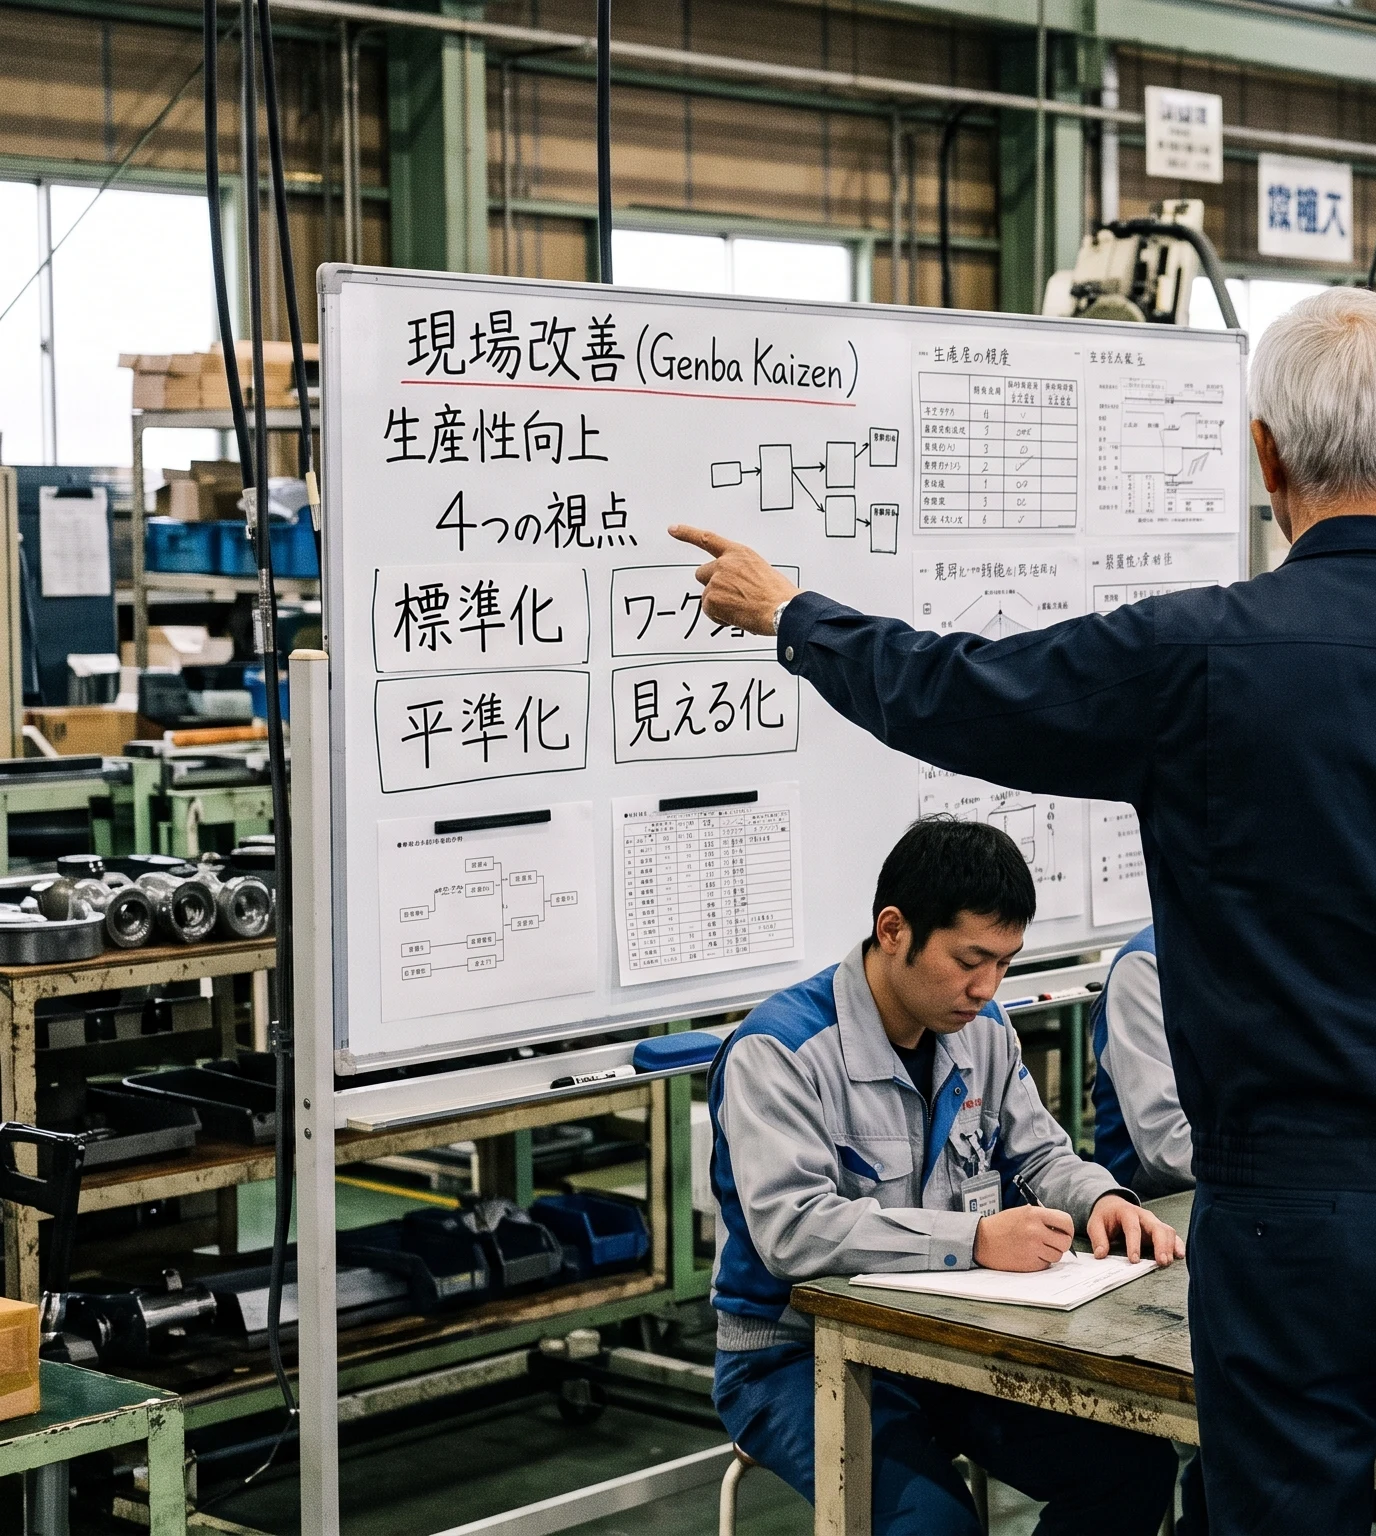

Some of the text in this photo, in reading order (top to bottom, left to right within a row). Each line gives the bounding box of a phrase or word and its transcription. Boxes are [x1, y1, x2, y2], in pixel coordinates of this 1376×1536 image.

[408, 310, 859, 398] 現場改善 (Genba Kaizen)
[384, 403, 608, 464] 生産性向上
[436, 491, 638, 551] 4つの視点
[394, 580, 562, 652] 標準化
[401, 693, 569, 768] 平準化
[630, 678, 784, 746] 見える化
